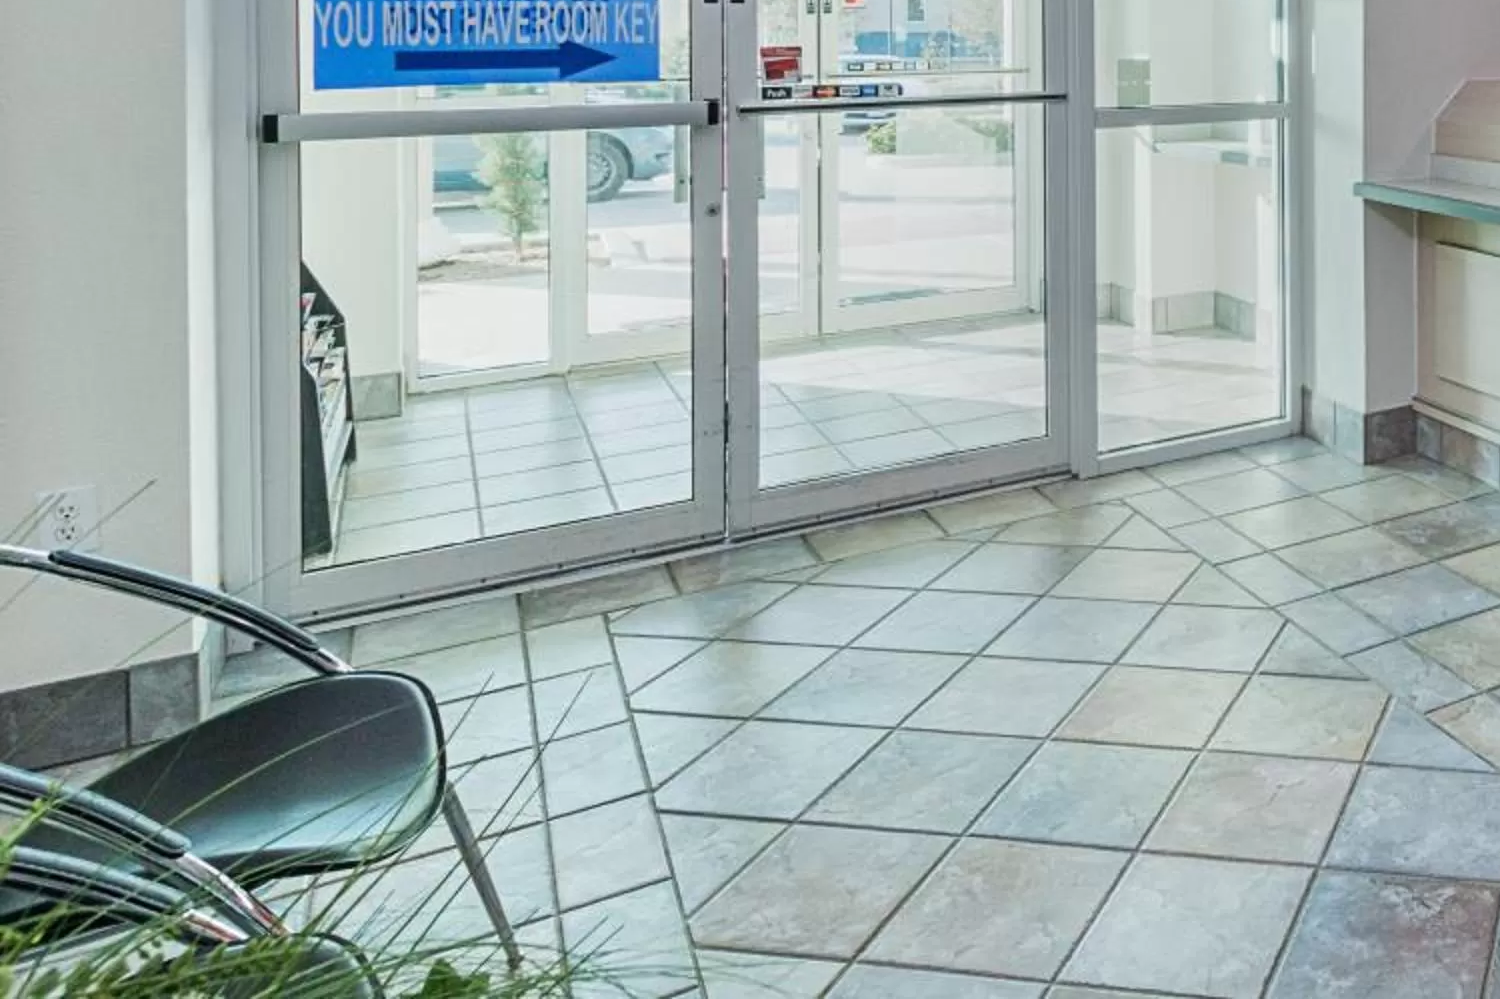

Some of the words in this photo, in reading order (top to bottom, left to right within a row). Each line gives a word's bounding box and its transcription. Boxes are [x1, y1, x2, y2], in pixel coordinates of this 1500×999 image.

[315, 1, 374, 48] YOU
[382, 1, 456, 47] MUST
[462, 1, 531, 46] HAVE
[535, 1, 607, 45] ROOM
[615, 1, 659, 45] KEY
